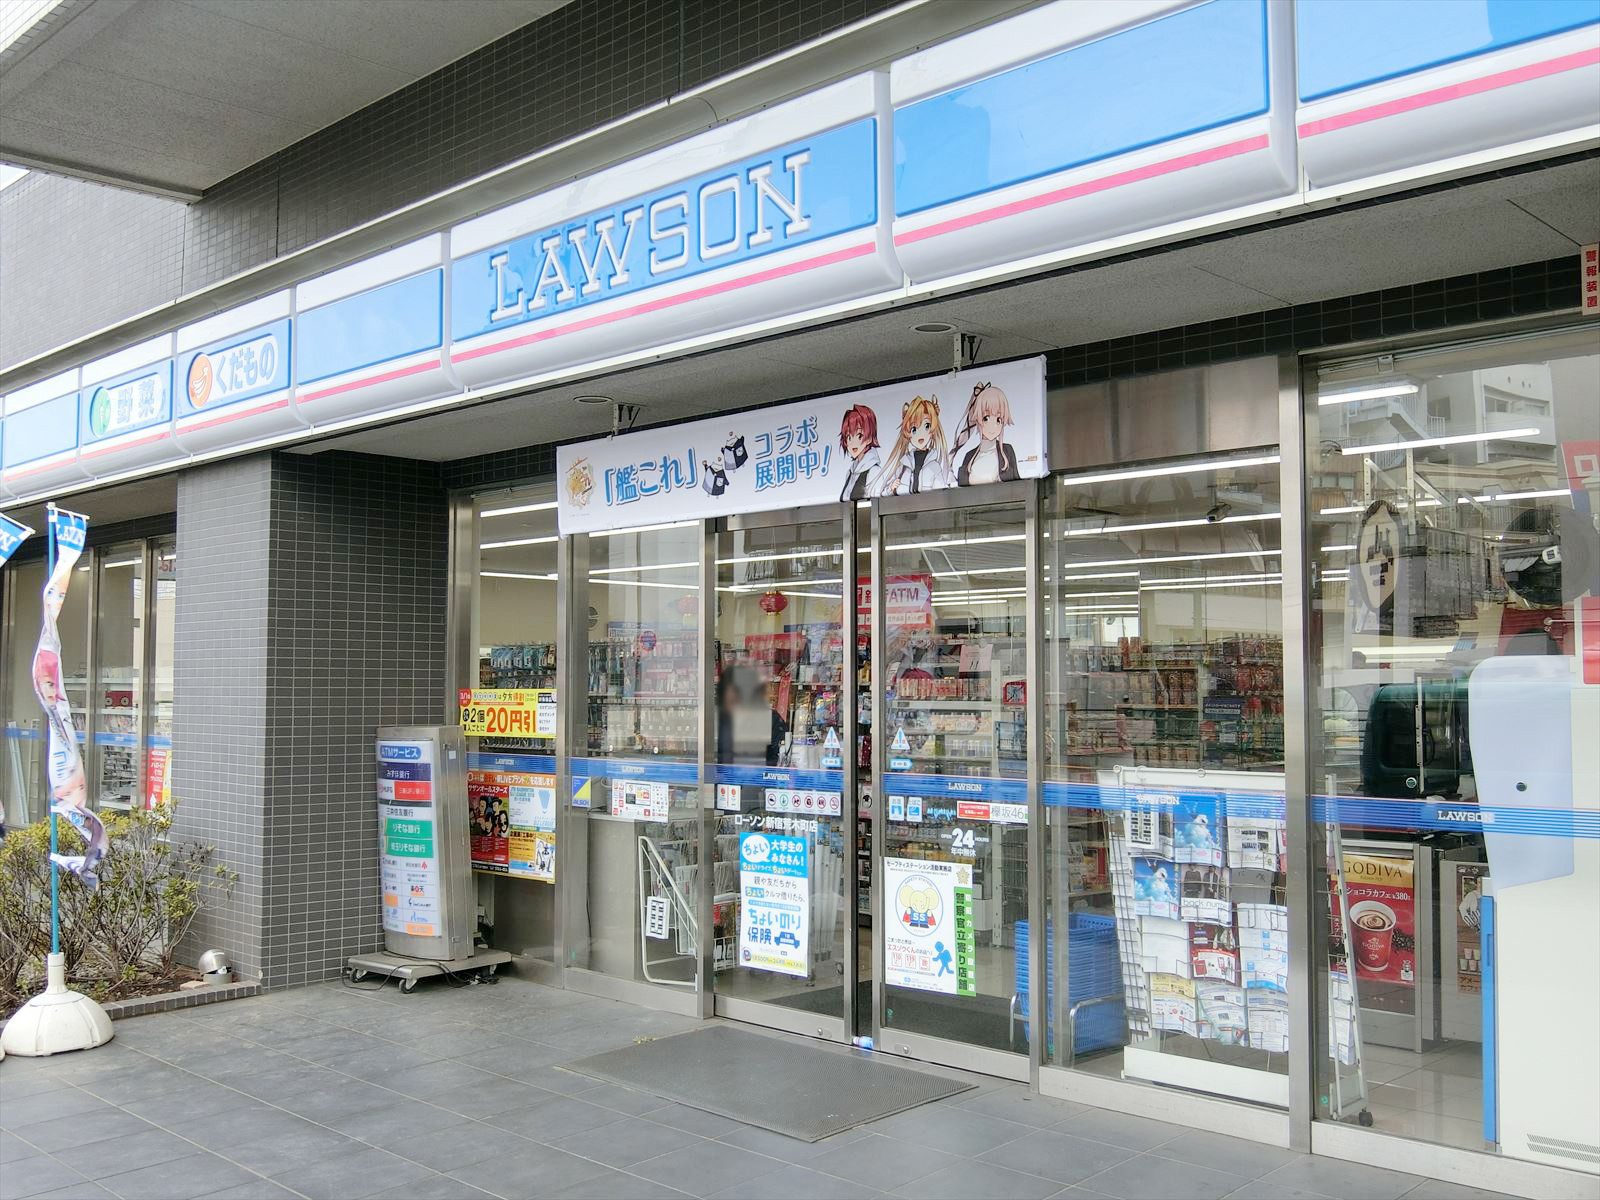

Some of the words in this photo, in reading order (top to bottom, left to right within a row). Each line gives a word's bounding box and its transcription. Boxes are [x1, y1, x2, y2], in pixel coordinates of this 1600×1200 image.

[490, 148, 812, 323] LAWSON
[1586, 249, 1598, 308] 警報装置
[215, 341, 276, 395] くだもの
[117, 378, 156, 425] 野菜
[754, 415, 819, 457] コラボ
[604, 445, 698, 507] 「艦これ」
[486, 706, 537, 734] 20円引
[948, 782, 983, 792] LAWSON
[735, 814, 818, 833] ローソン新宿荒木町店
[1437, 810, 1495, 823] LAWSON
[393, 823, 420, 834] りそな銀行
[952, 827, 975, 849] 24
[744, 842, 769, 856] ちょい
[771, 840, 804, 854] 大学生の
[951, 848, 977, 857] 年中無休
[1343, 860, 1403, 878] GODIVA
[754, 876, 798, 890] 親や友だちから
[1346, 886, 1391, 899] ショコラカフェ
[748, 908, 801, 930] ちょいのり
[913, 912, 926, 921] SS
[747, 926, 772, 945] 保険
